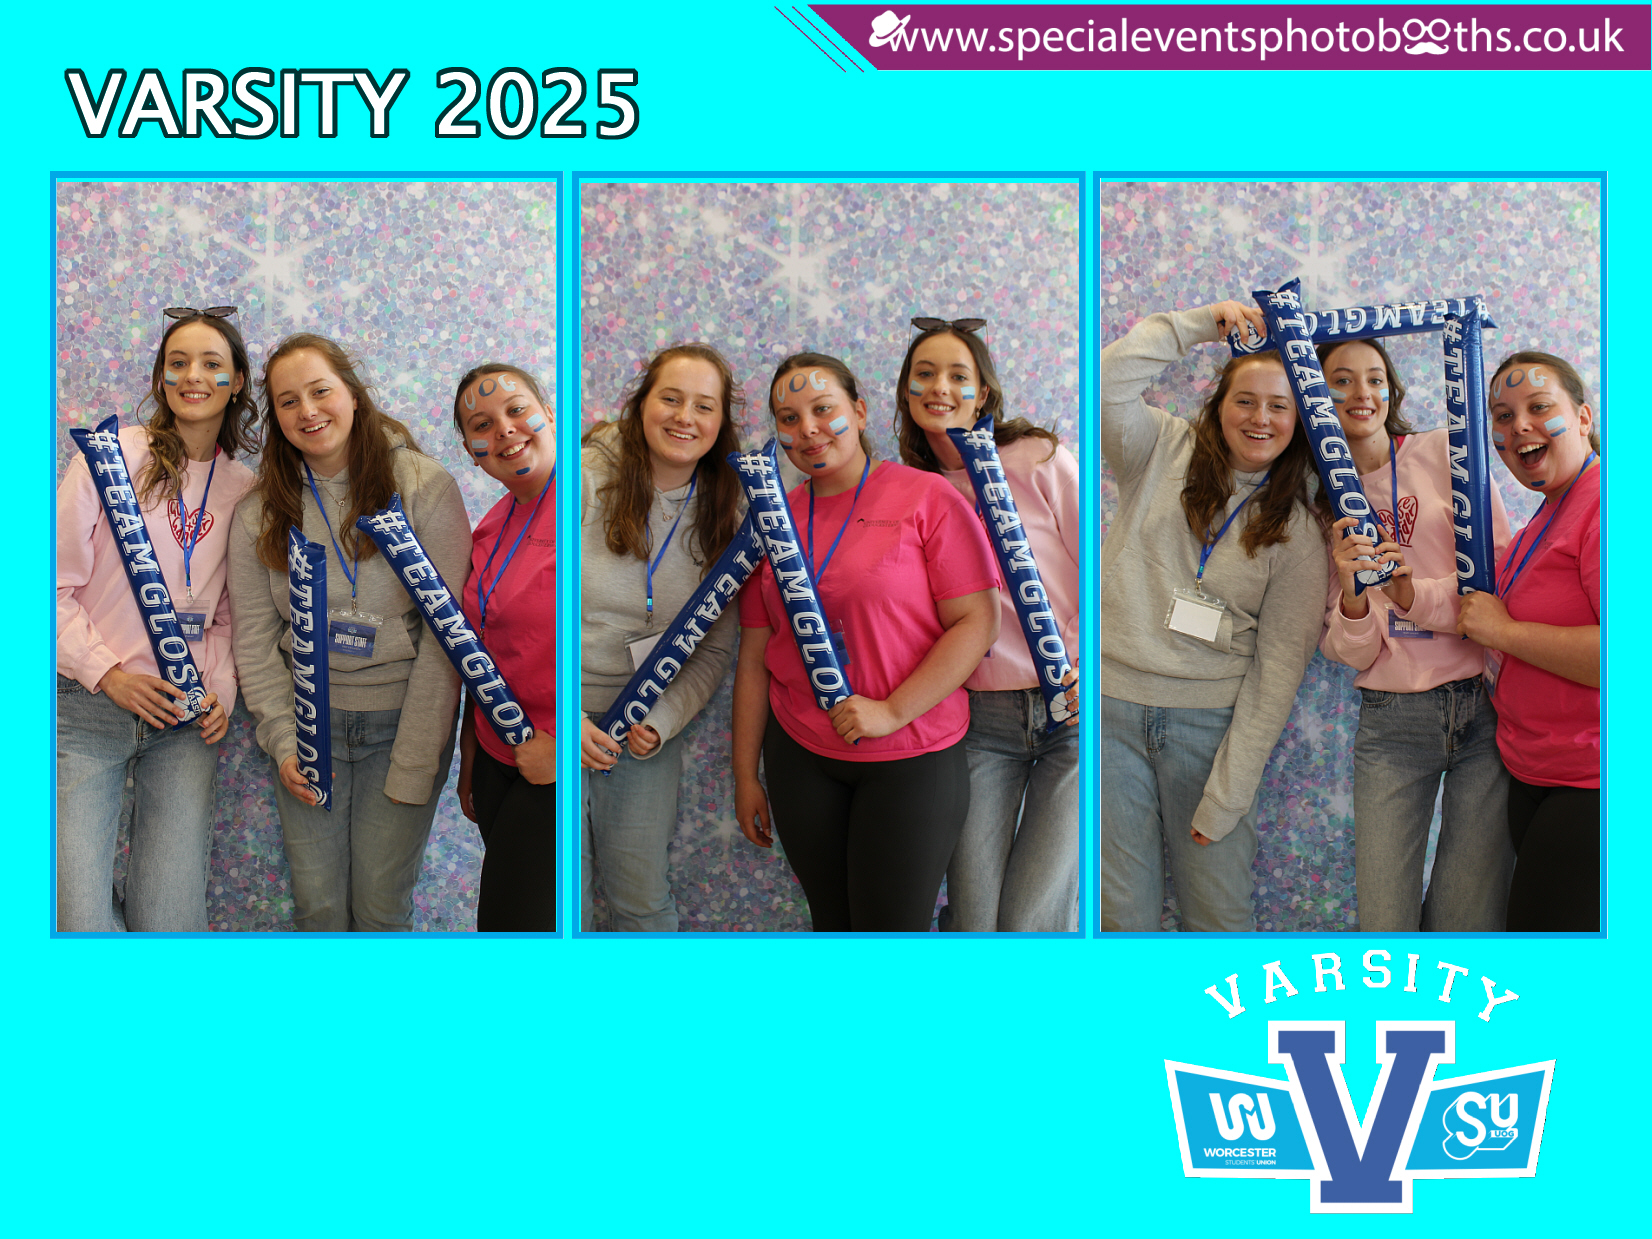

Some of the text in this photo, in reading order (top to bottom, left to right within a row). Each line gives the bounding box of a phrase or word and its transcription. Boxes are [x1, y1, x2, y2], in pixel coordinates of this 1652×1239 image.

[464, 374, 517, 411] UOG
[776, 370, 827, 403] UOG
[1493, 367, 1548, 399] UOG
[84, 428, 199, 687] #TEAMGLOS
